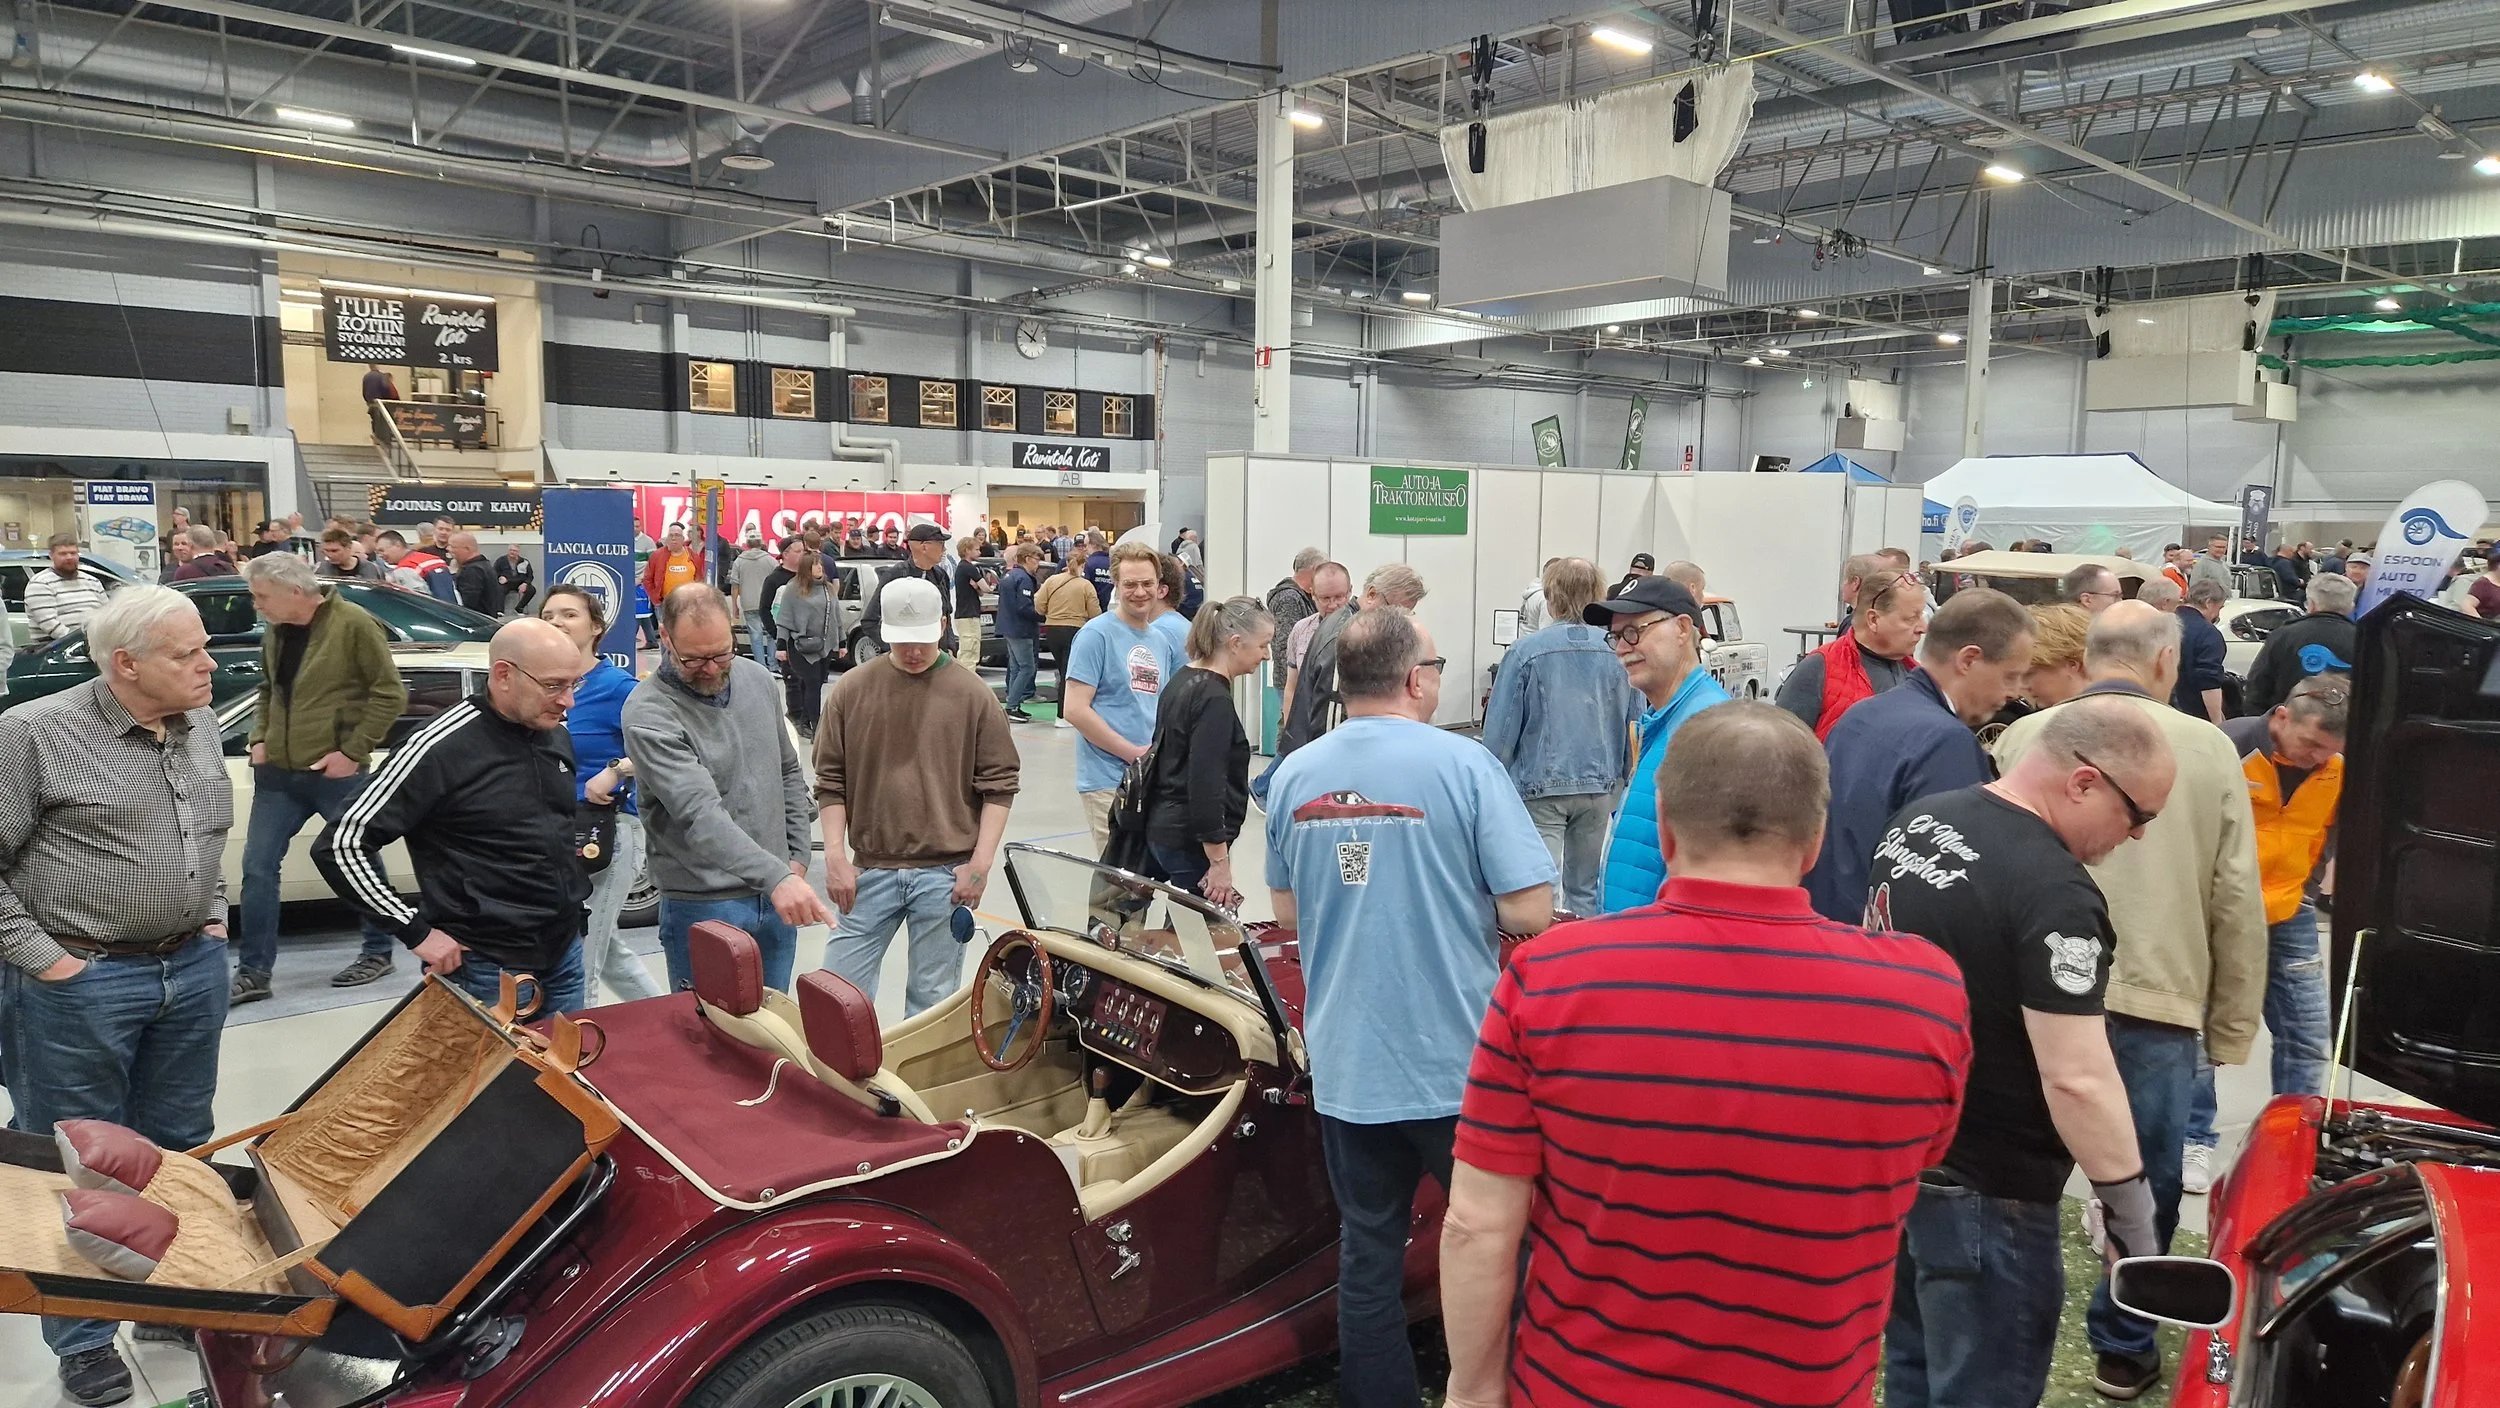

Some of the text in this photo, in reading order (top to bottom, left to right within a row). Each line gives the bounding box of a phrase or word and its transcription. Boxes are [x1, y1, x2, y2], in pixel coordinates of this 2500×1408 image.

[335, 296, 404, 320] TULE
[336, 316, 404, 335] KOTIIN
[438, 353, 473, 365] 2. krs
[1023, 444, 1101, 468] Ravintola Koti
[1061, 472, 1080, 486] AB
[92, 485, 113, 494] FIAT
[116, 485, 149, 494] BRAVO
[1373, 484, 1466, 507] TRAKTORIMUSEO
[94, 494, 149, 502] FIAT BRAVA
[386, 500, 531, 513] LOUNAS OLUT KAHVI
[547, 543, 629, 556] LANCIA CLUB
[2384, 555, 2444, 567] ESPOON
[1095, 568, 1111, 576] SAA
[2379, 572, 2417, 582] AUTO
[1873, 827, 1969, 890] Slingshot
